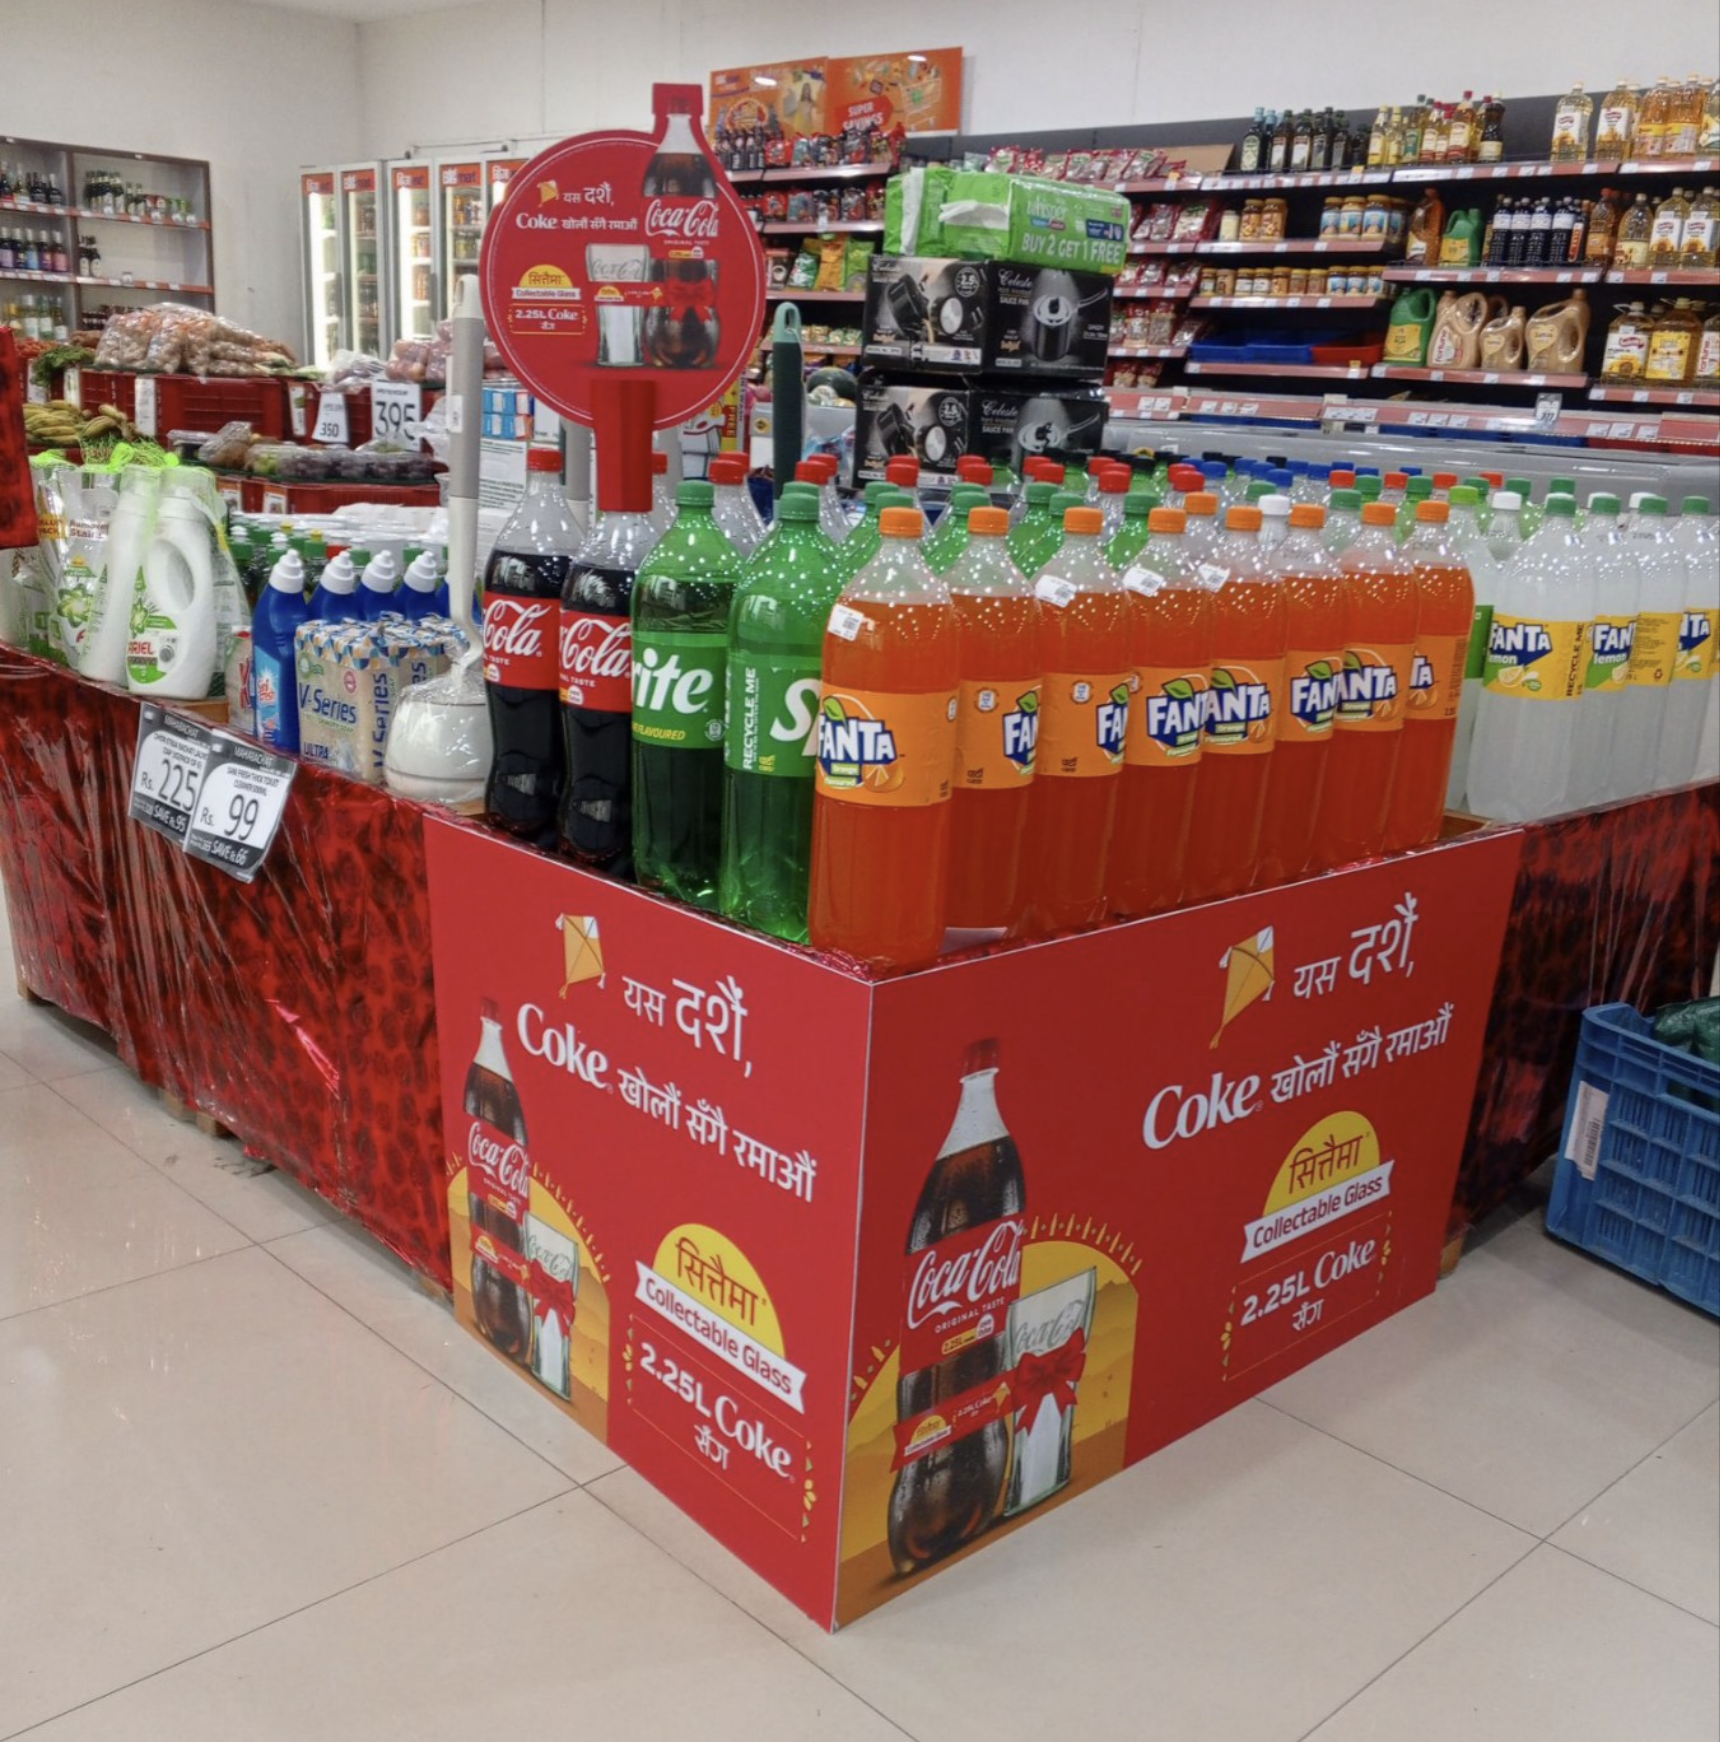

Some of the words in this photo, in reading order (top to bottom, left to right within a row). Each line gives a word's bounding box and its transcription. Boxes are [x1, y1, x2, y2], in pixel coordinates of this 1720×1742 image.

[563, 192, 581, 203] यस
[516, 212, 557, 229] Coke
[645, 199, 719, 237] Coca-Cola
[1022, 233, 1045, 253] BUY
[1047, 233, 1056, 256] 2
[1058, 239, 1081, 258] GET
[1083, 240, 1088, 259] 1
[1091, 241, 1121, 265] FREE
[548, 308, 578, 320] Coke
[320, 422, 339, 437] 350
[375, 401, 416, 440] 395
[726, 406, 737, 437] FREE
[1488, 653, 1518, 665] emon
[1566, 644, 1579, 696] RECYCLE
[1577, 622, 1584, 642] ME
[1594, 653, 1627, 665] lemon
[571, 676, 596, 687] TASTE
[744, 667, 756, 694] ME
[298, 682, 357, 724] V-Series
[303, 742, 328, 759] ULTRA
[638, 723, 686, 741] FLAVOURED
[743, 697, 756, 770] RECYCLE
[141, 772, 154, 791] Rs.
[158, 758, 198, 812] 225
[154, 804, 170, 823] SAVE
[200, 807, 214, 826] Rs.
[224, 794, 259, 841] 99
[211, 840, 230, 859] SAVE
[1293, 956, 1341, 999] यस
[622, 975, 666, 1027] यस
[1143, 1072, 1260, 1150] Coke
[1270, 1040, 1341, 1103] खोलौं
[1342, 1025, 1382, 1078] सँगै
[1385, 1001, 1454, 1062] रमाऔं
[516, 1002, 608, 1089] Coke
[617, 1066, 681, 1130] खोलौं
[685, 1098, 728, 1156] सँगै
[732, 1129, 817, 1202] रमाऔं
[468, 1122, 531, 1199] Coca-Cola
[1253, 1193, 1341, 1249] Collectable
[1343, 1175, 1383, 1206] Glass
[907, 1219, 1025, 1330] Coca-Cola
[1240, 1271, 1311, 1326] 2.25L
[1313, 1239, 1375, 1289] Coke
[935, 1308, 979, 1334] ORIGINAL
[981, 1297, 1005, 1312] TASTE
[645, 1277, 738, 1359] Collectable
[743, 1344, 791, 1395] Glass
[640, 1342, 711, 1418] 2.25L
[715, 1395, 792, 1478] Coke
